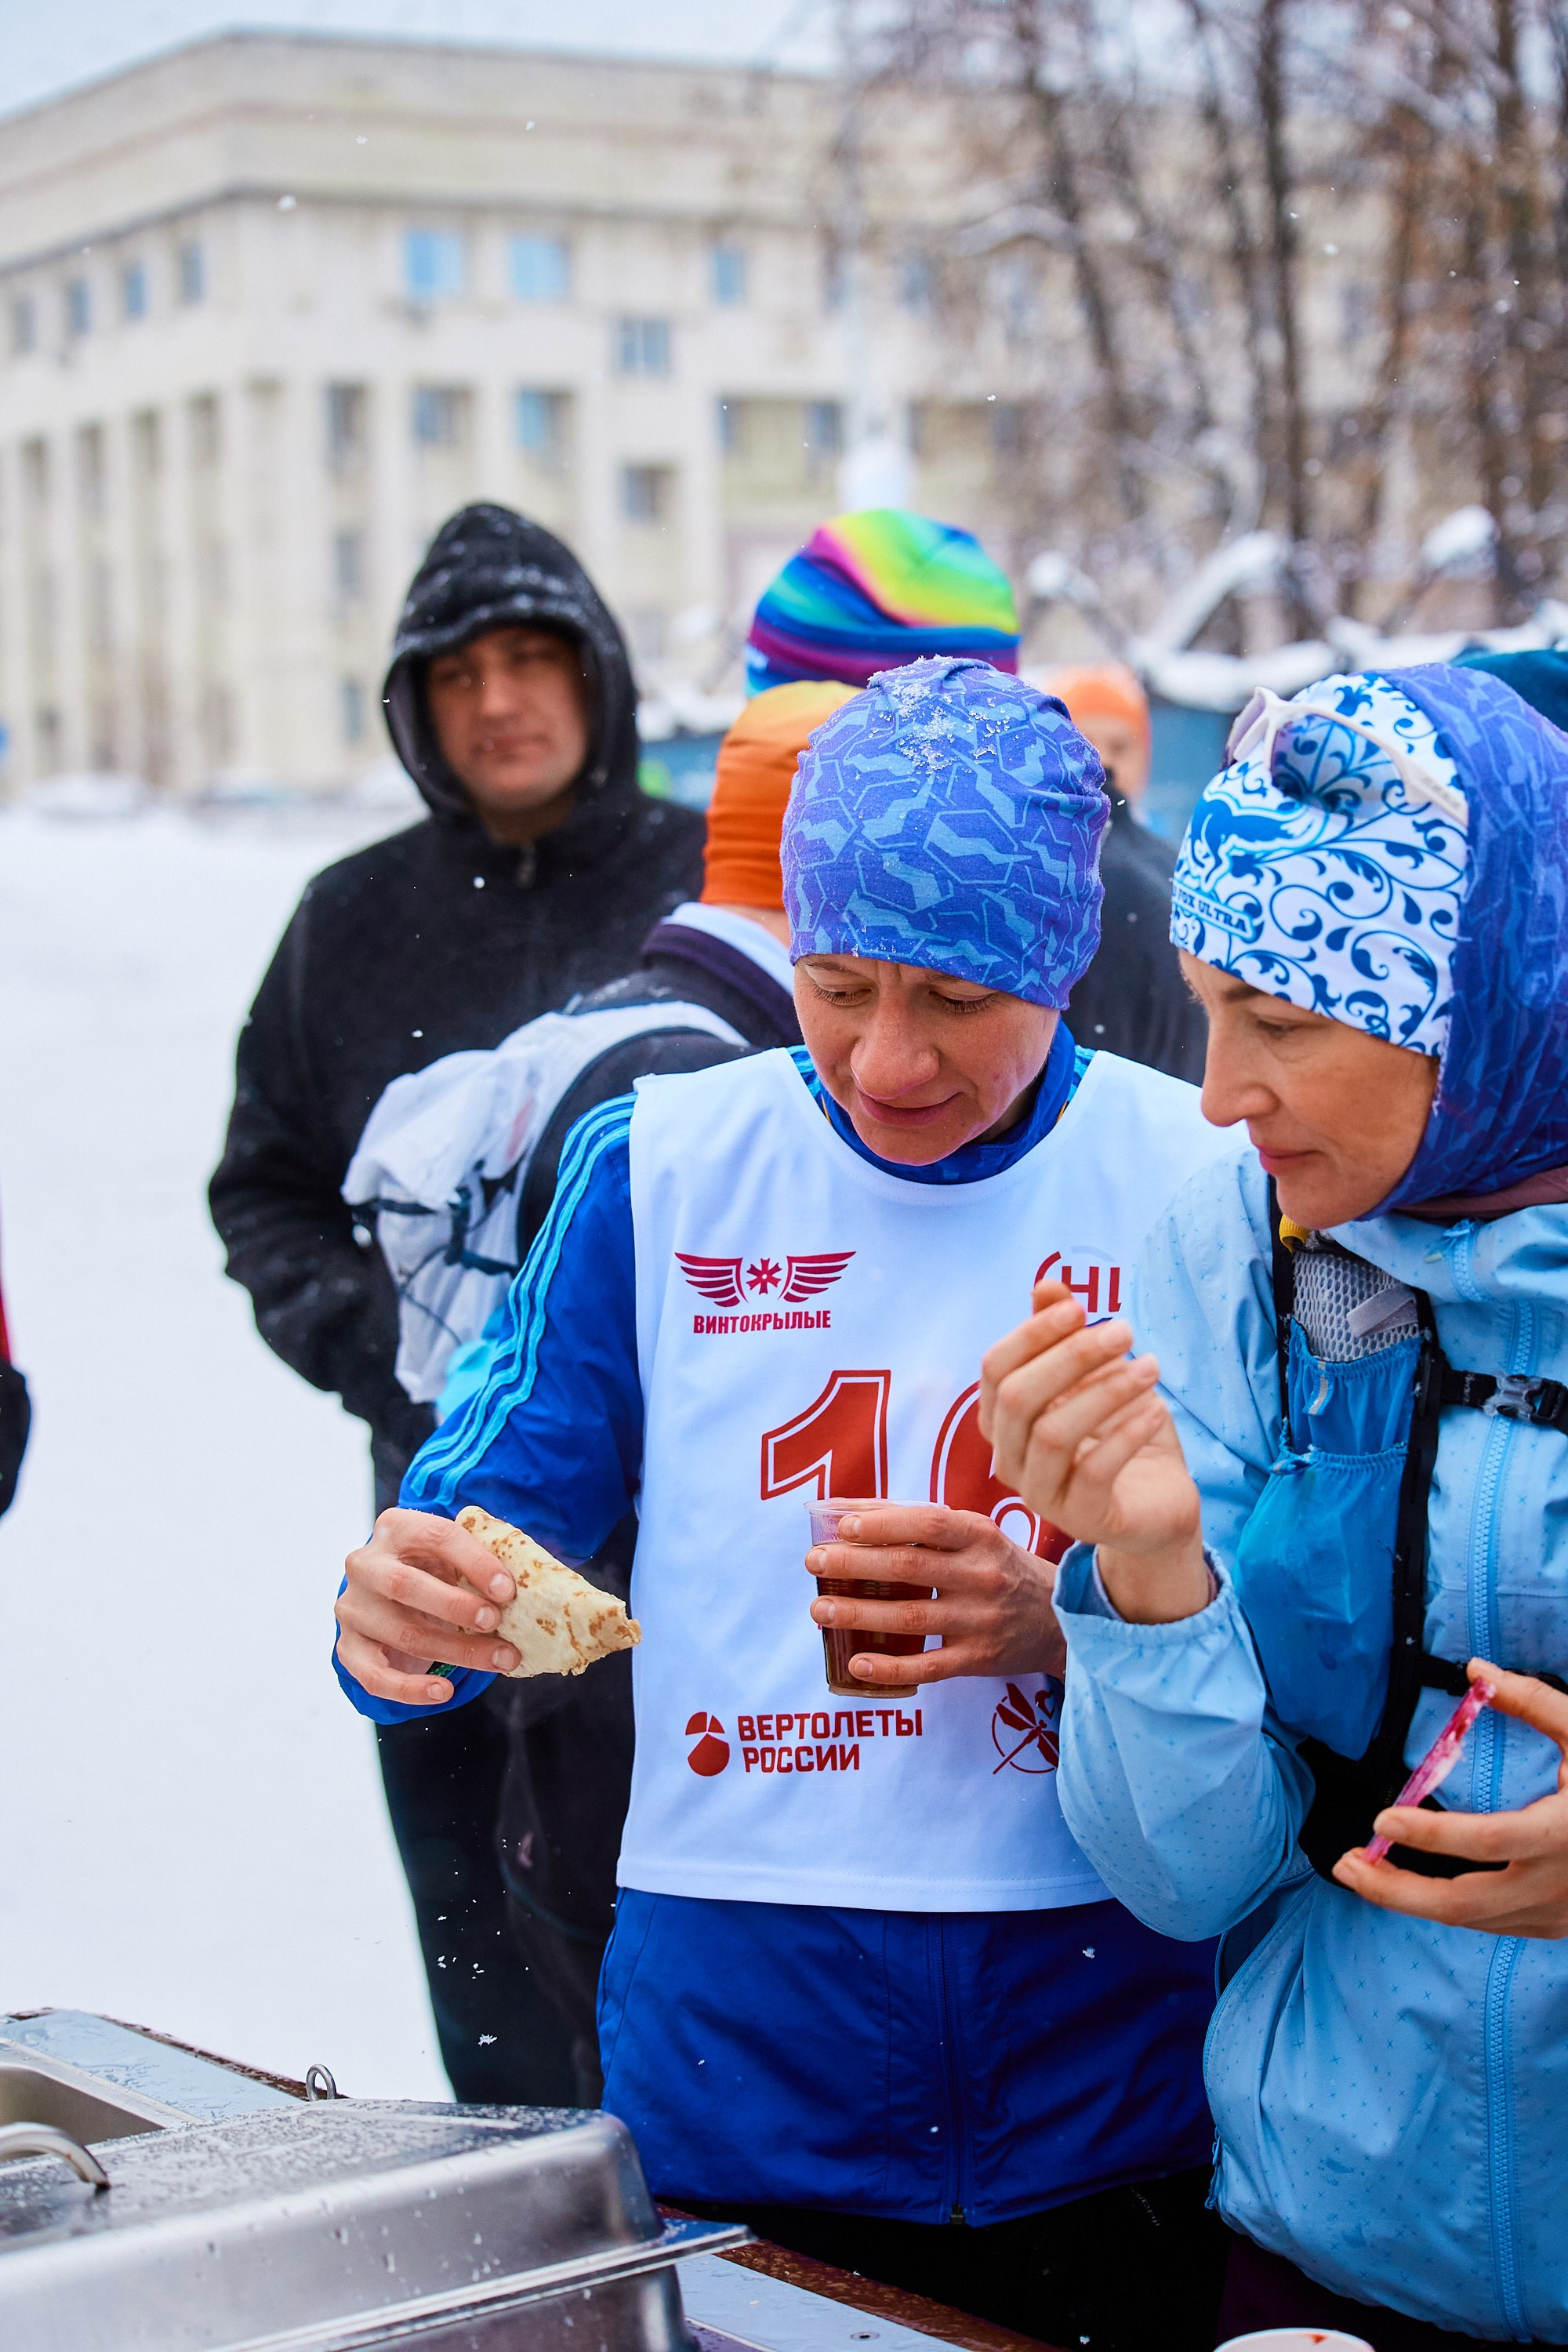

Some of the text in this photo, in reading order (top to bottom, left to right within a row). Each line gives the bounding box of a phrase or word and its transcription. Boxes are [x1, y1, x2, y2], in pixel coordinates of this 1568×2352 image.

[1199, 900, 1247, 933] ULTRA
[693, 1310, 831, 1334] ВИНТОКРЫЛЫЕ
[737, 1708, 923, 1741] ВЕРТОЛЕТЫ
[742, 1744, 860, 1773] РОССИИ
